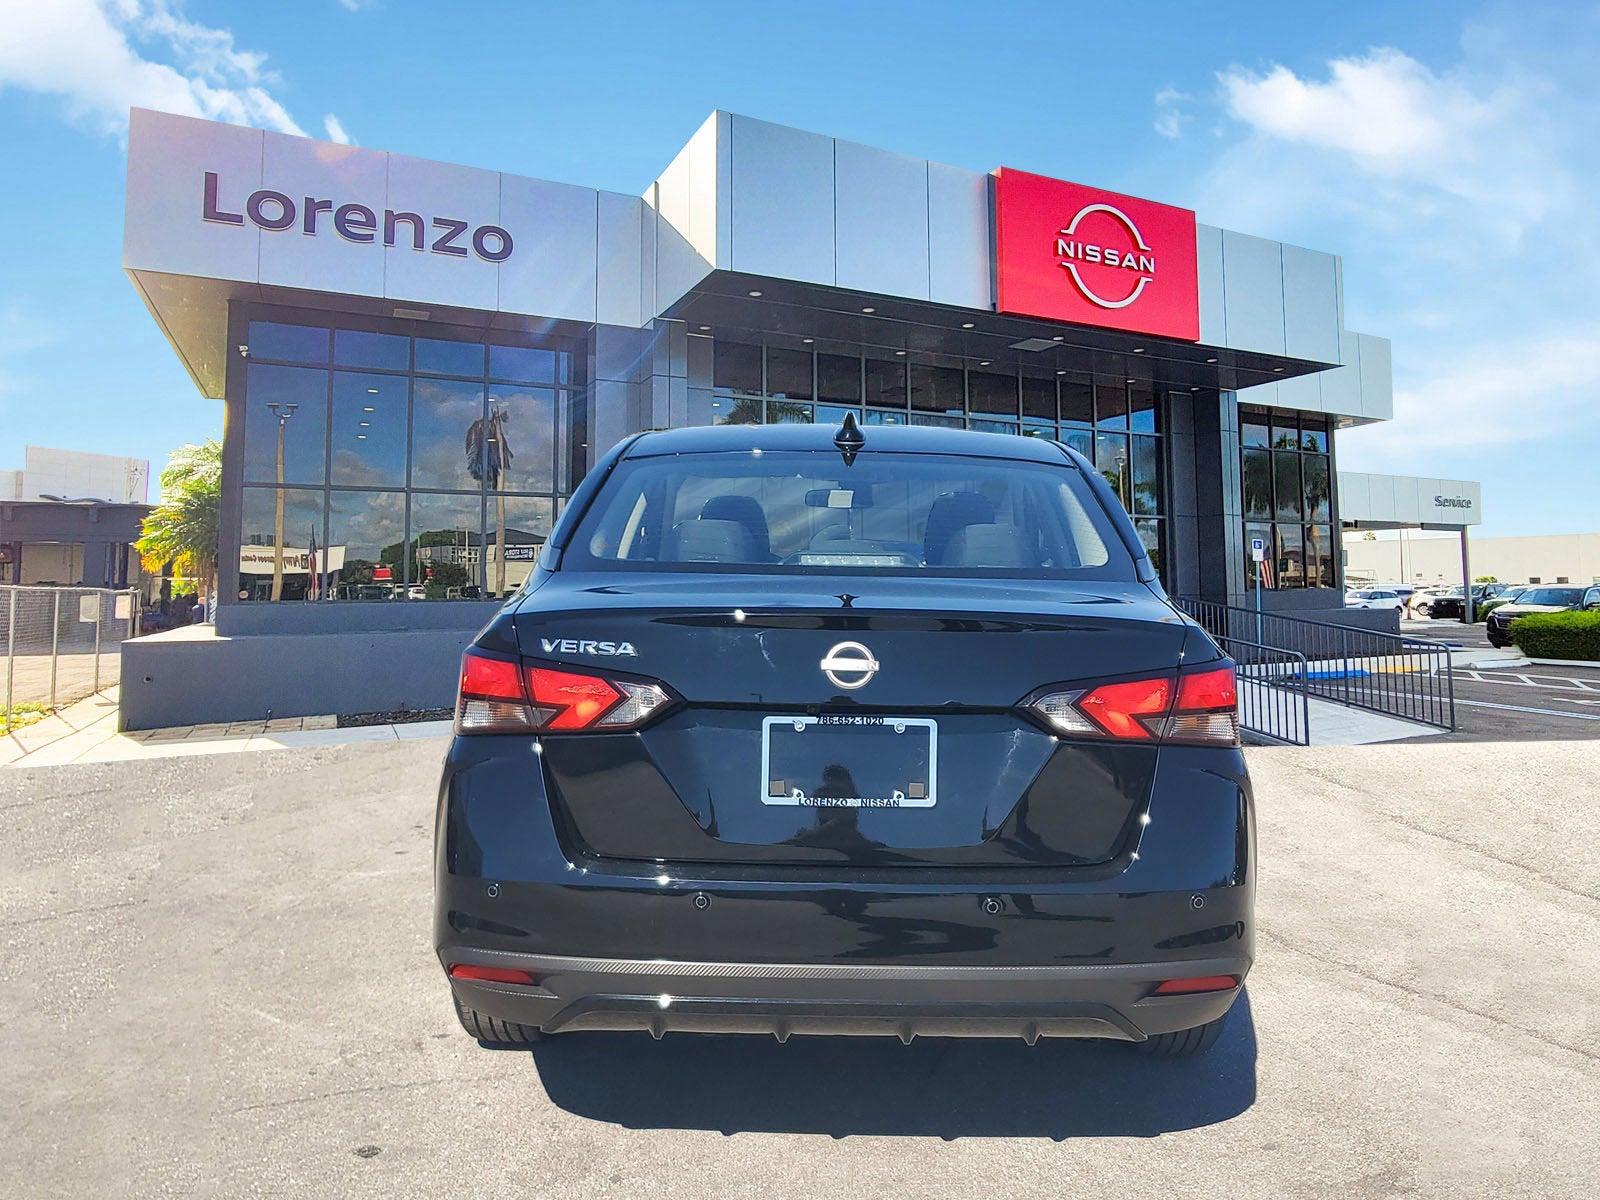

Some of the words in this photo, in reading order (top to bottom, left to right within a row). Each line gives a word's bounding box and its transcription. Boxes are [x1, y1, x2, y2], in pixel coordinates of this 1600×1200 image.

[202, 171, 514, 262] Lorenzo
[1058, 238, 1155, 273] NISSAN
[1434, 495, 1472, 508] Service
[540, 638, 638, 656] VERSA
[798, 798, 848, 808] LORENZO
[860, 799, 900, 808] NISSAN
